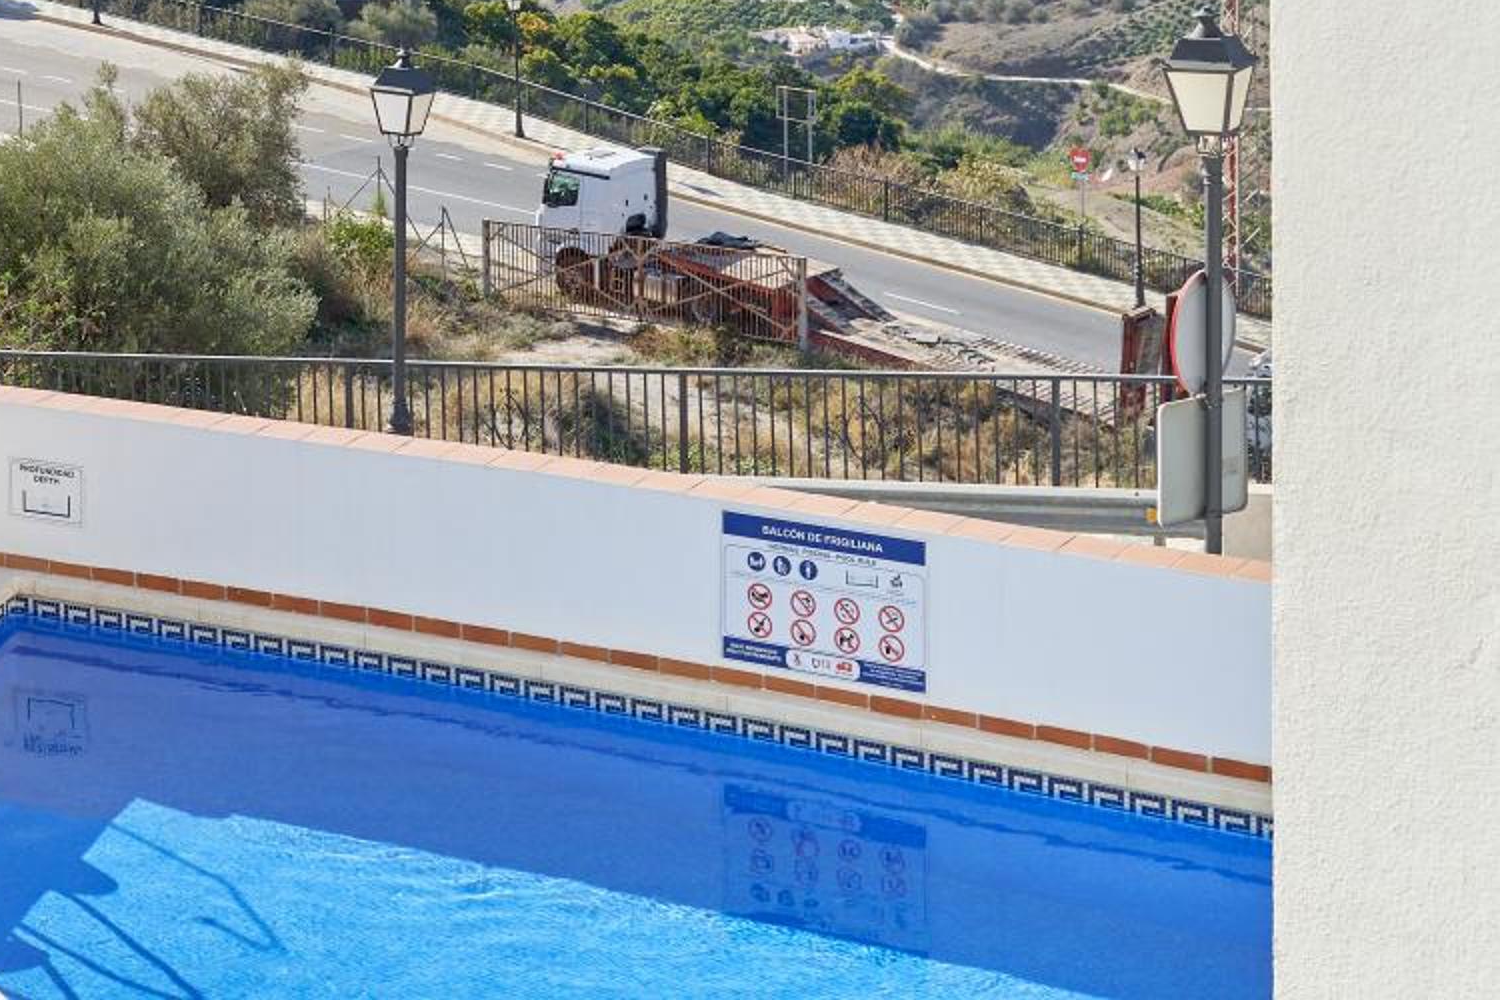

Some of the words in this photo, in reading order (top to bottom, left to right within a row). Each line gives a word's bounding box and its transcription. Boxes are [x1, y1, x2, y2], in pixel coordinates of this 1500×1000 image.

[762, 525, 805, 540] BALCÓN
[807, 533, 821, 543] DE
[823, 535, 883, 553] FRIGILIANA
